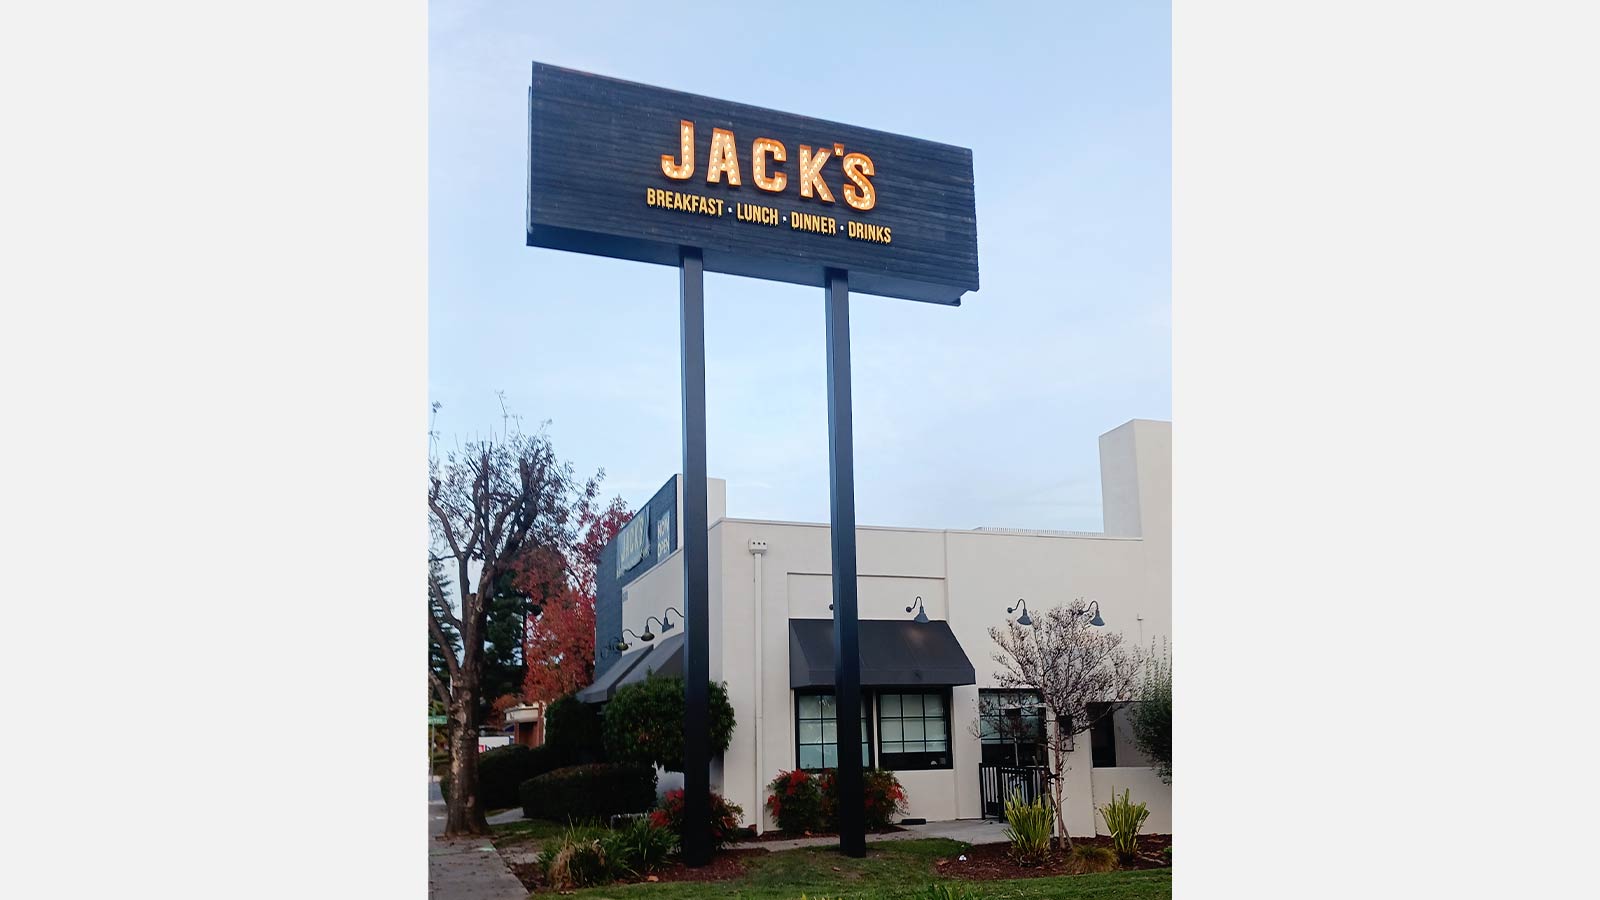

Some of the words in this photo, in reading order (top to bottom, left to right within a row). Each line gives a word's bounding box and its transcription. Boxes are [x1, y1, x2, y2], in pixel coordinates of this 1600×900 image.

[660, 119, 876, 211] JACK'S
[646, 187, 724, 217] BREAKFAST
[736, 202, 779, 226] LUNCH
[791, 211, 836, 235] DINNER
[848, 221, 892, 244] DRINKS
[657, 536, 670, 558] OPEN
